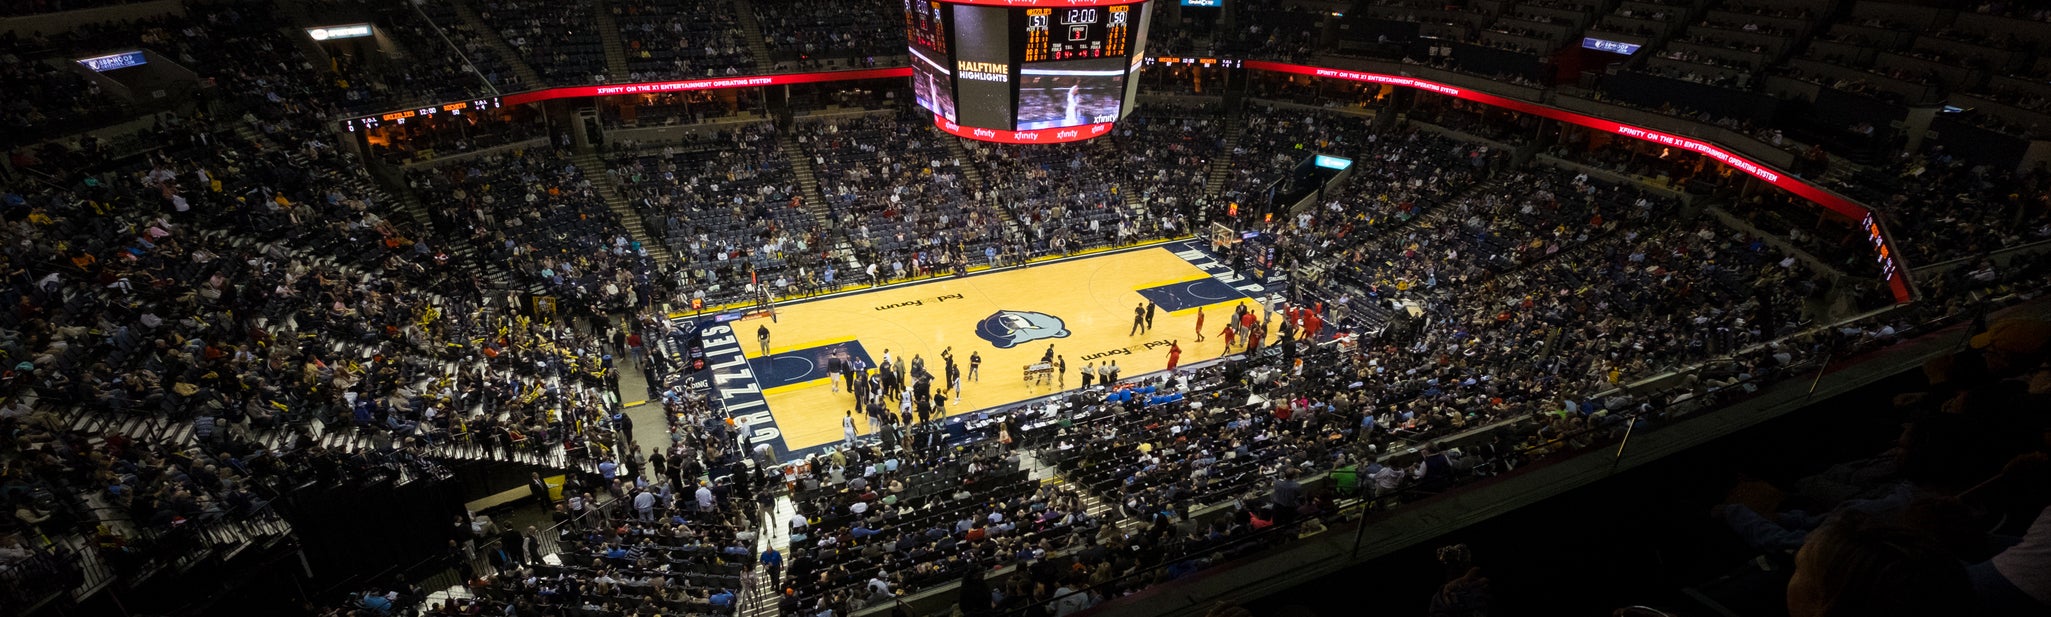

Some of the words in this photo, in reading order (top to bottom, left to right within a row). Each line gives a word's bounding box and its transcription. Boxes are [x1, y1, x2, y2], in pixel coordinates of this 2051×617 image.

[1026, 8, 1052, 16] GRIZZLIES
[1109, 5, 1129, 13] ROCKETS
[1034, 15, 1046, 26] 57
[1067, 9, 1096, 23] 12:00
[1114, 12, 1125, 23] 50
[1075, 31, 1080, 40] 3
[1056, 51, 1061, 60] 0
[1094, 49, 1099, 57] 0
[958, 61, 1008, 74] HALFTIME
[959, 71, 1008, 82] HIGHLIGHTS
[660, 81, 712, 90] ENTERTAINMENT
[713, 79, 748, 87] OPERATING
[1316, 69, 1338, 77] XFINITY
[1367, 75, 1414, 85] ENTERTAINMENT
[1414, 81, 1440, 91] OPERATING
[1440, 86, 1459, 95] SYSTEM
[419, 107, 437, 116] 12:00
[443, 103, 467, 111] ROCKETS
[383, 111, 415, 121] GRIZZLIES
[1093, 114, 1119, 124] xfinity
[974, 128, 996, 139] xfinity
[1013, 132, 1038, 140] xfinity
[1057, 129, 1078, 139] xfinity
[1618, 126, 1646, 137] XFINITY
[1660, 136, 1674, 144] THE
[1684, 141, 1729, 161] ENTERTAINMENT
[1728, 156, 1757, 173] OPERATING
[1756, 168, 1778, 182] SYSTEM
[701, 325, 781, 444] GRIZZLIES
